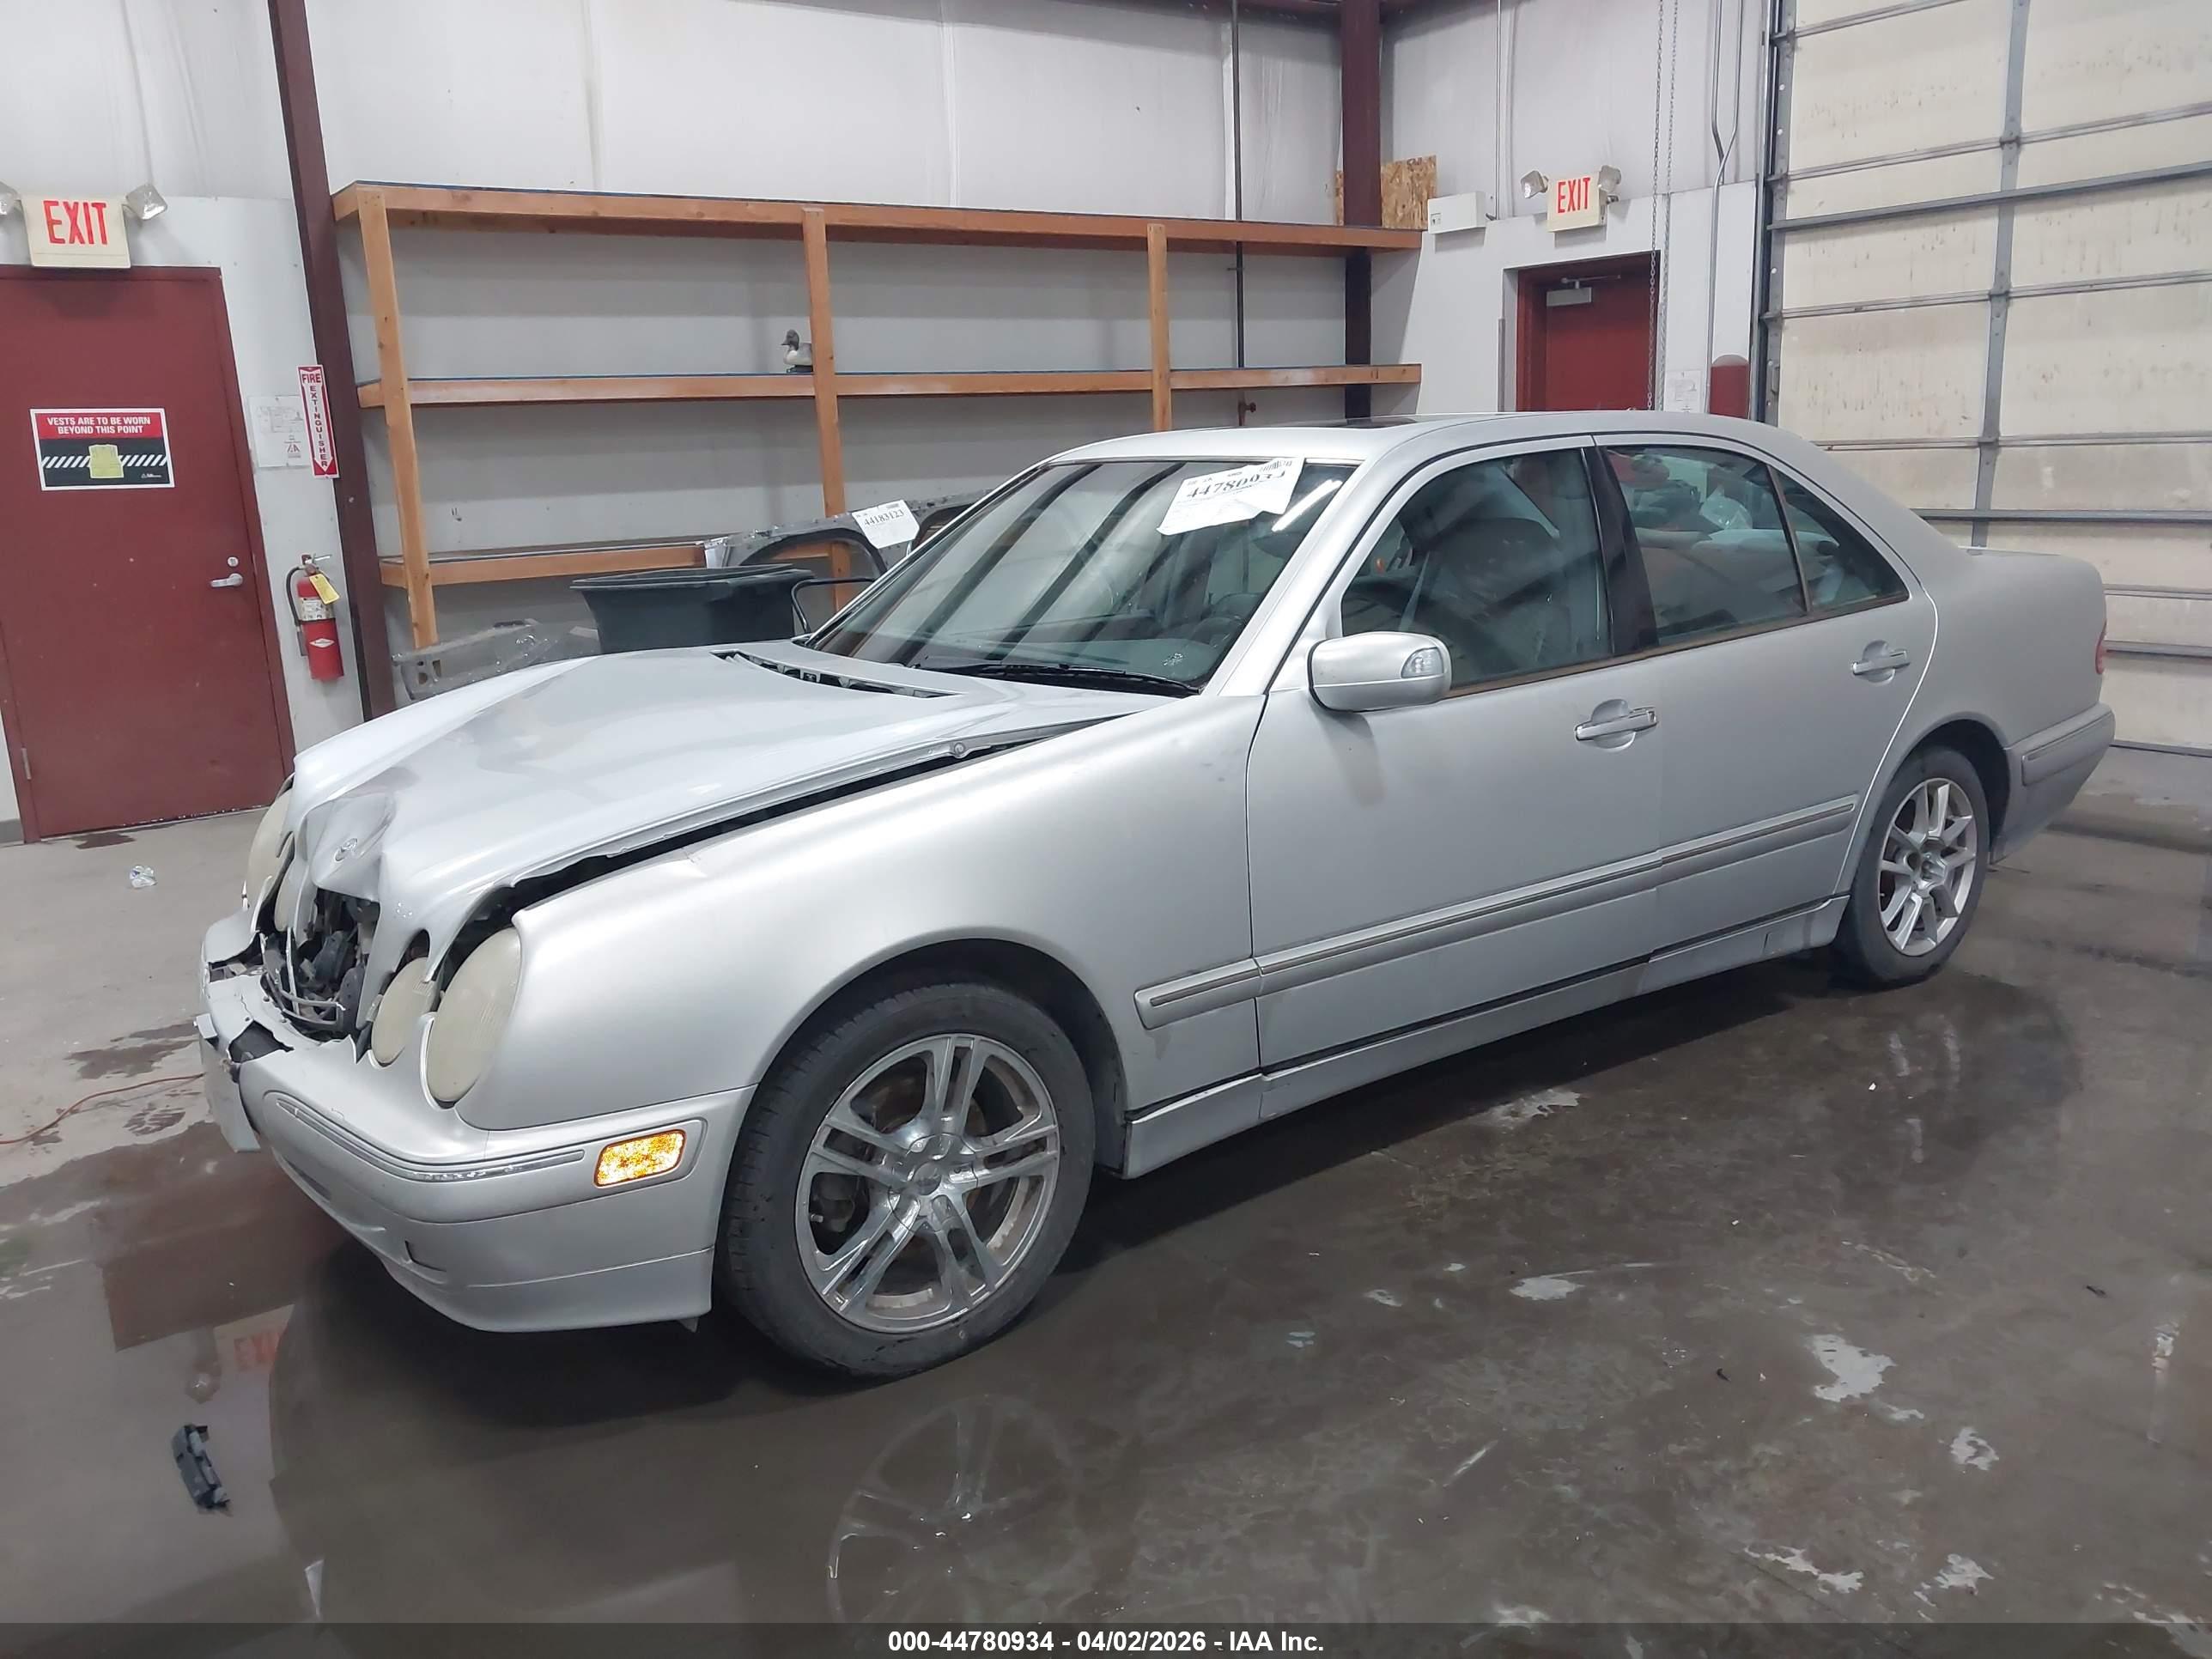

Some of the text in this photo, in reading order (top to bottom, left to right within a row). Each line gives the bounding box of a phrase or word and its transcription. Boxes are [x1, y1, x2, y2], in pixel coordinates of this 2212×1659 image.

[1558, 177, 1591, 214] EXIT
[43, 200, 108, 245] EXIT
[301, 373, 322, 384] FIRE
[47, 416, 151, 426] VESTS ARE TO BE WORN
[58, 426, 94, 434] BEYOND
[117, 425, 143, 434] POINT
[309, 385, 328, 467] EXTINGUISHER
